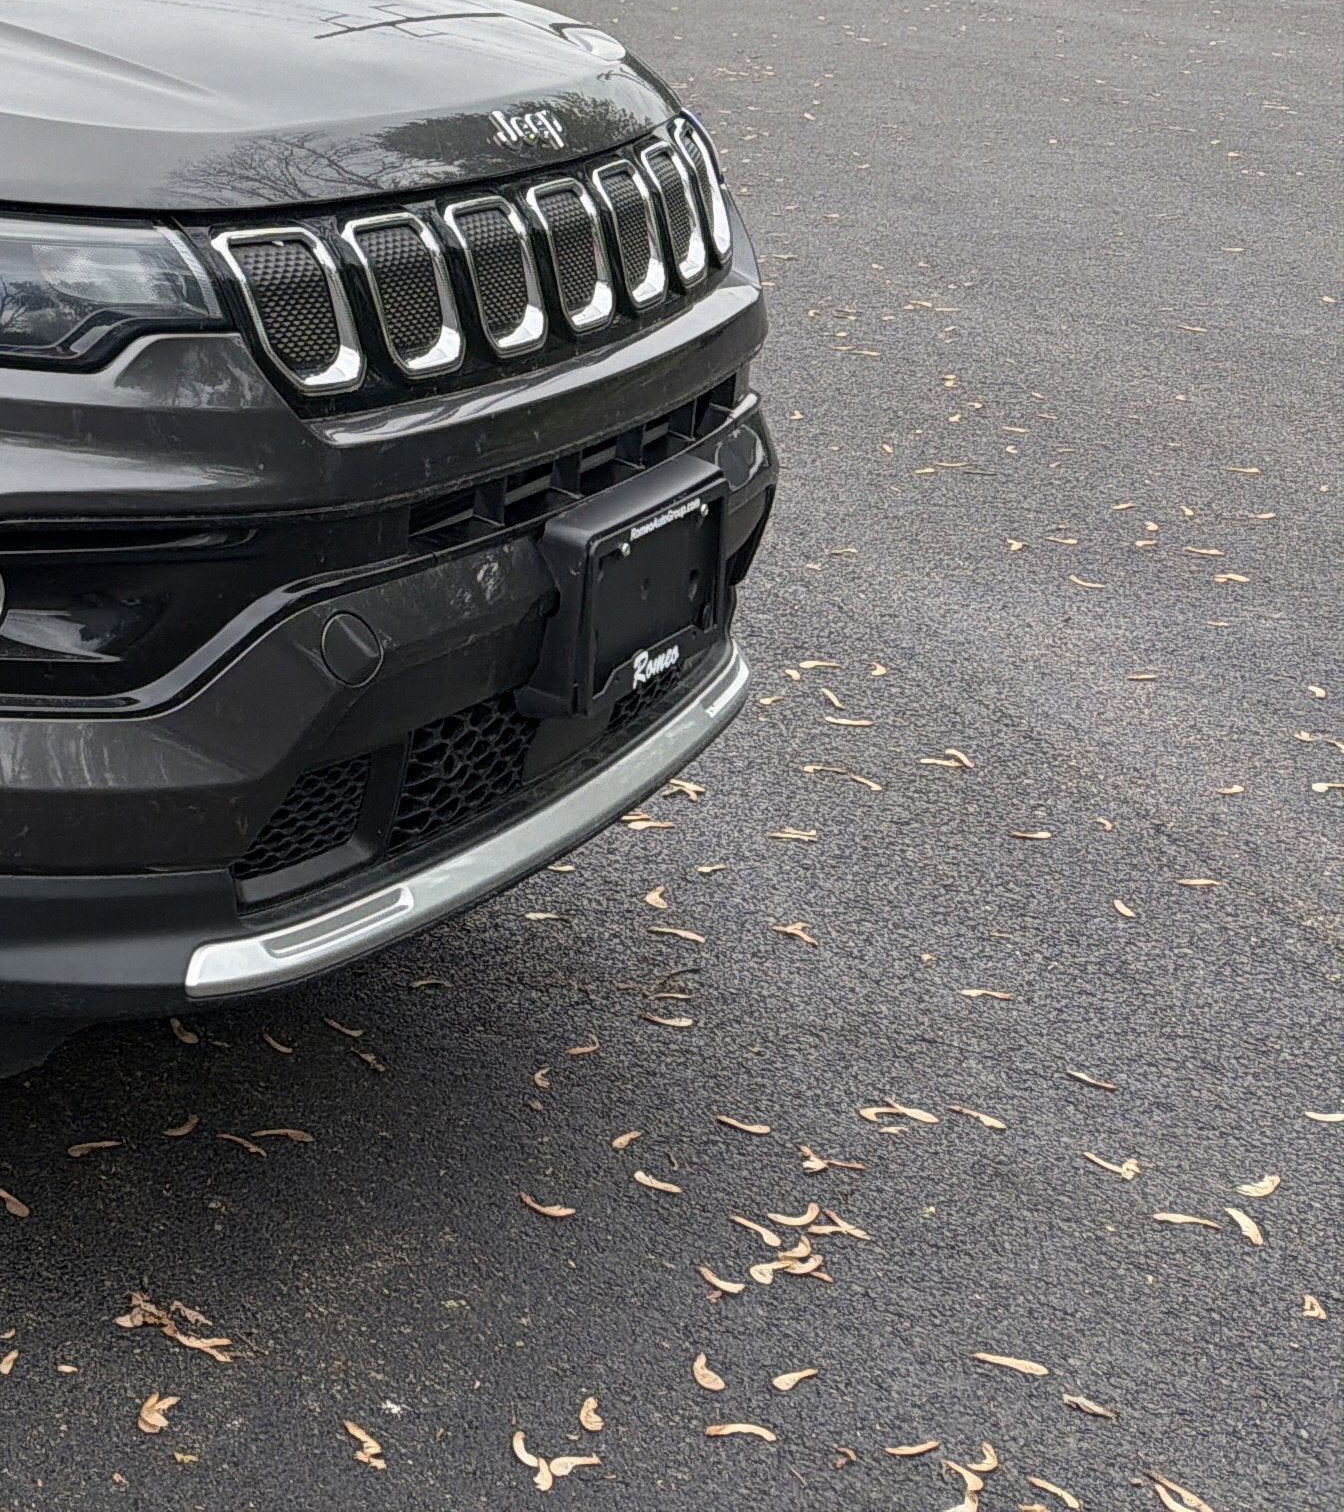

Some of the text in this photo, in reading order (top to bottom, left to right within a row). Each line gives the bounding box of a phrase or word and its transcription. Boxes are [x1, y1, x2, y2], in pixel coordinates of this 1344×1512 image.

[492, 109, 565, 149] Jeep
[629, 498, 701, 541] RomeoAutoGroup.com
[632, 644, 680, 690] Romeo
